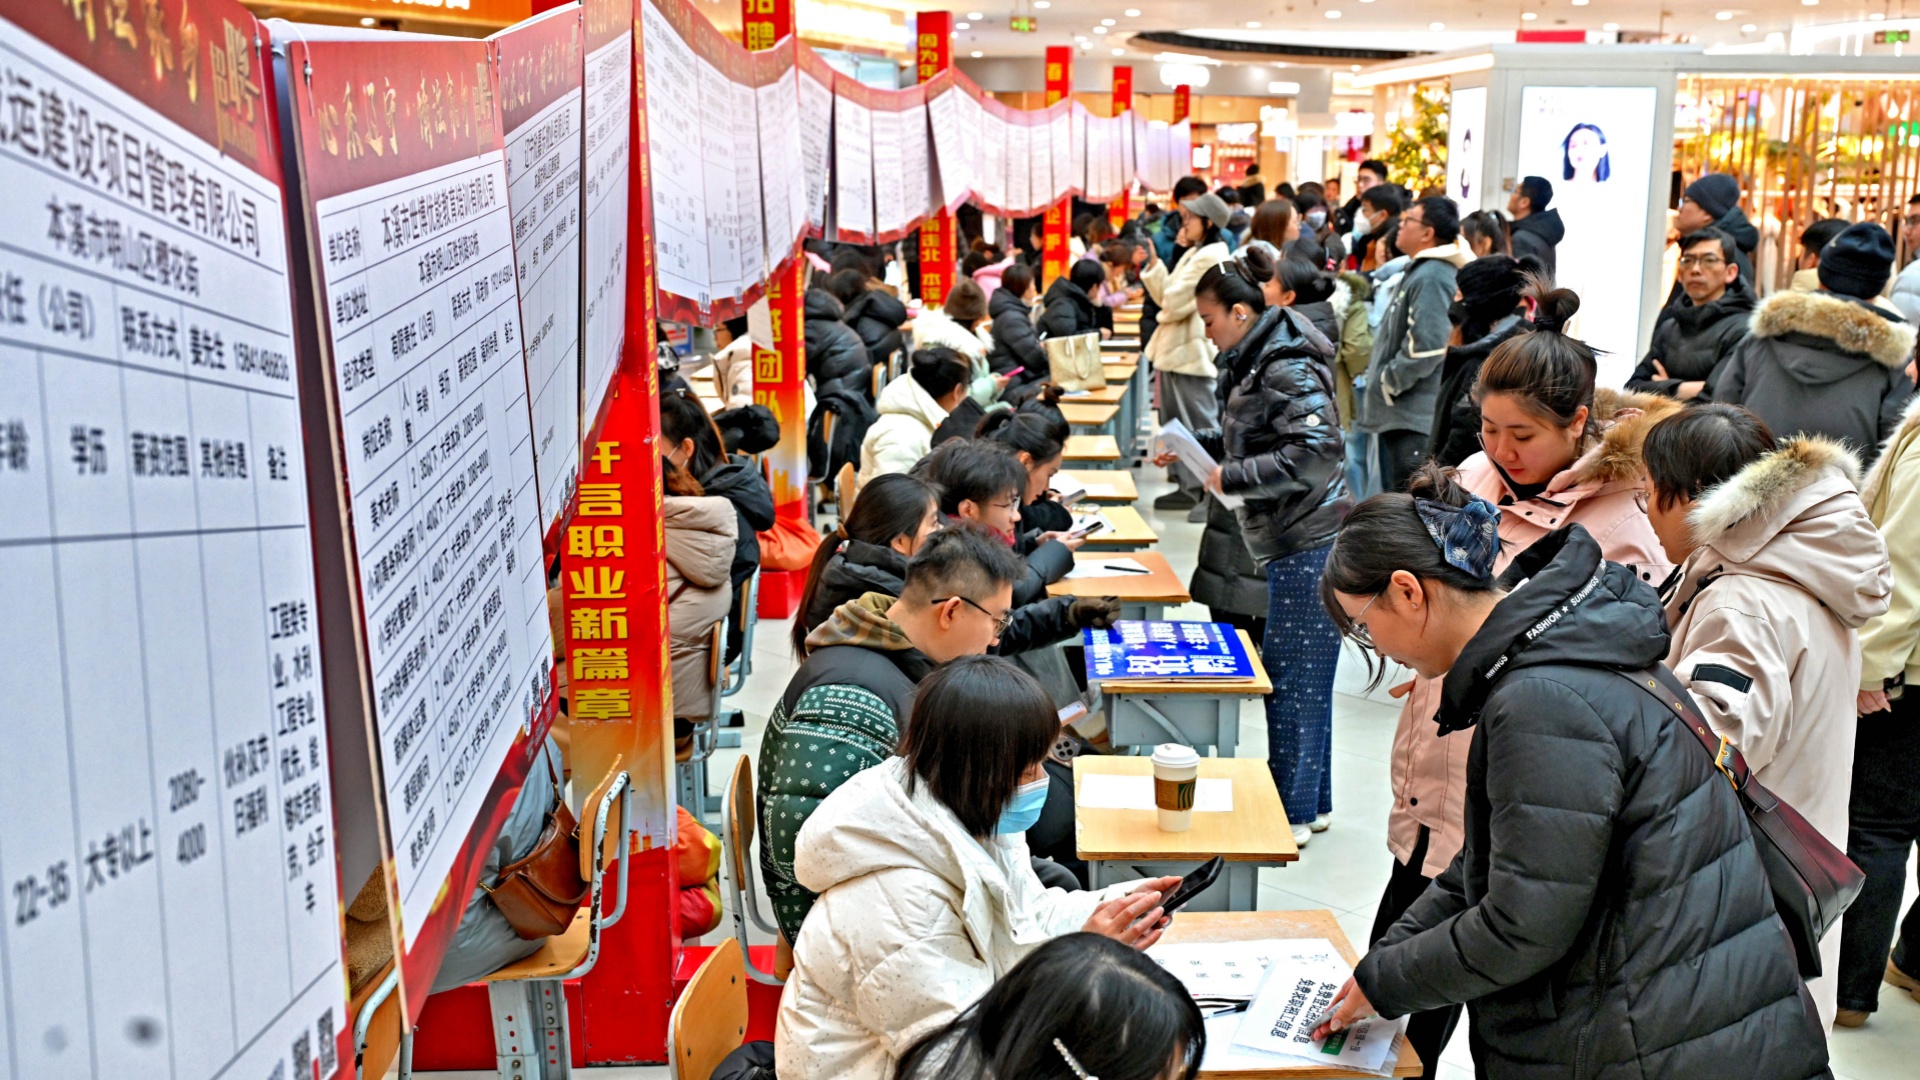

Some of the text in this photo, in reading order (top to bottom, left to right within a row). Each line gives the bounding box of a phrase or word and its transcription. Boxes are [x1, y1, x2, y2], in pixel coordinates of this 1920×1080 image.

[919, 33, 938, 84] 因为年
[0, 57, 260, 263] 运建设项目管理有限公司
[327, 224, 362, 268] 单位名称
[0, 264, 94, 344] 任（公司）
[334, 283, 368, 329] 单位地址
[451, 285, 472, 322] 联系方式
[121, 302, 180, 365] 联系方式
[503, 316, 513, 346] 备注
[341, 344, 376, 395] 经济类型
[438, 366, 451, 400] 学历
[415, 382, 430, 420] 年龄
[70, 425, 106, 477] 学历
[131, 428, 190, 481] 薪资范围
[266, 444, 288, 483] 备注
[361, 412, 393, 465] 岗位名称
[438, 421, 461, 464] 大学本科
[369, 477, 400, 533] 美术老师
[444, 471, 466, 516] 大学本科
[449, 519, 471, 566] 大学本科
[1525, 575, 1600, 640] FASHION SUNWINGS
[83, 816, 154, 896] 大专以上
